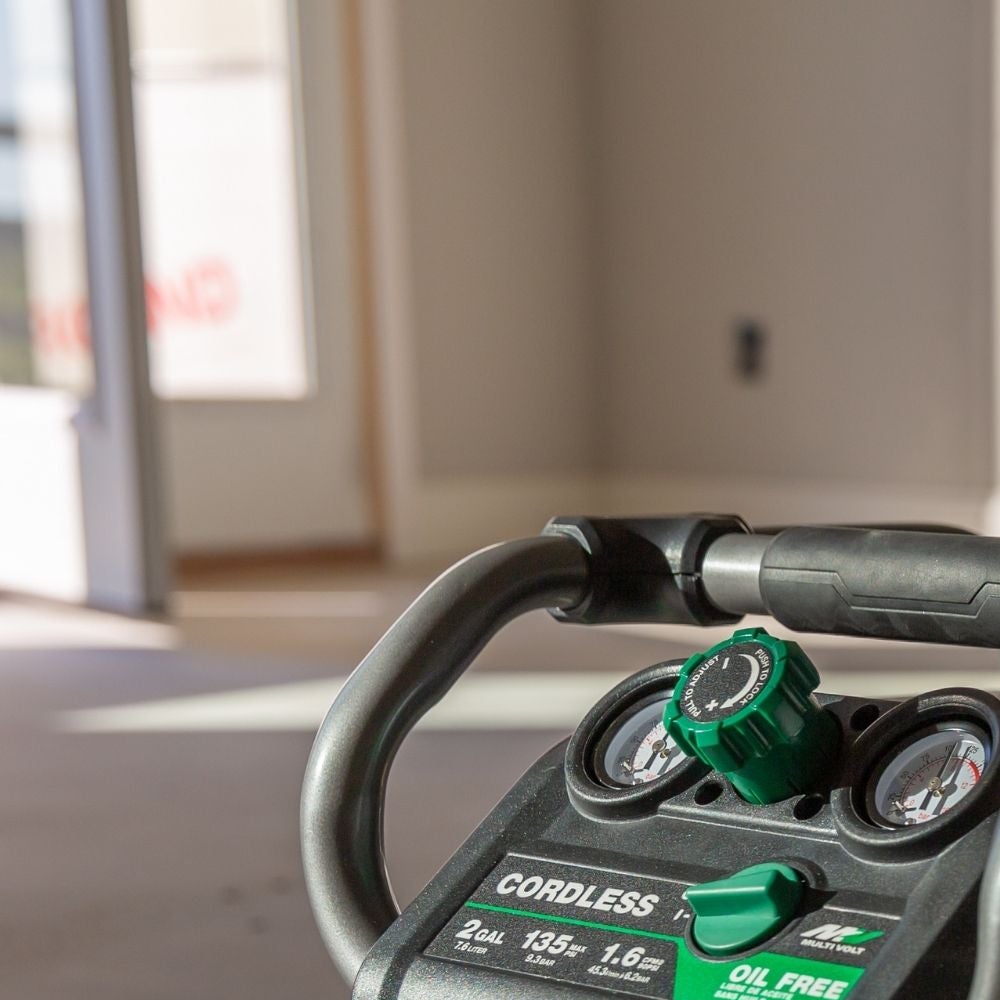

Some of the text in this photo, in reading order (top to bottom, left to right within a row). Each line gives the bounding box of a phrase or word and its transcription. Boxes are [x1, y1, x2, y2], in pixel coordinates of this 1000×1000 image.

[684, 654, 720, 718] PULL TO ADJUST
[739, 648, 770, 706] PUSH TO LOCK
[496, 872, 661, 917] CORDLESS
[521, 929, 575, 954] 135
[568, 943, 588, 953] MAX
[600, 943, 646, 967] 1.6
[800, 938, 866, 955] MULTI VOLT
[729, 964, 849, 1000] OIL FREE
